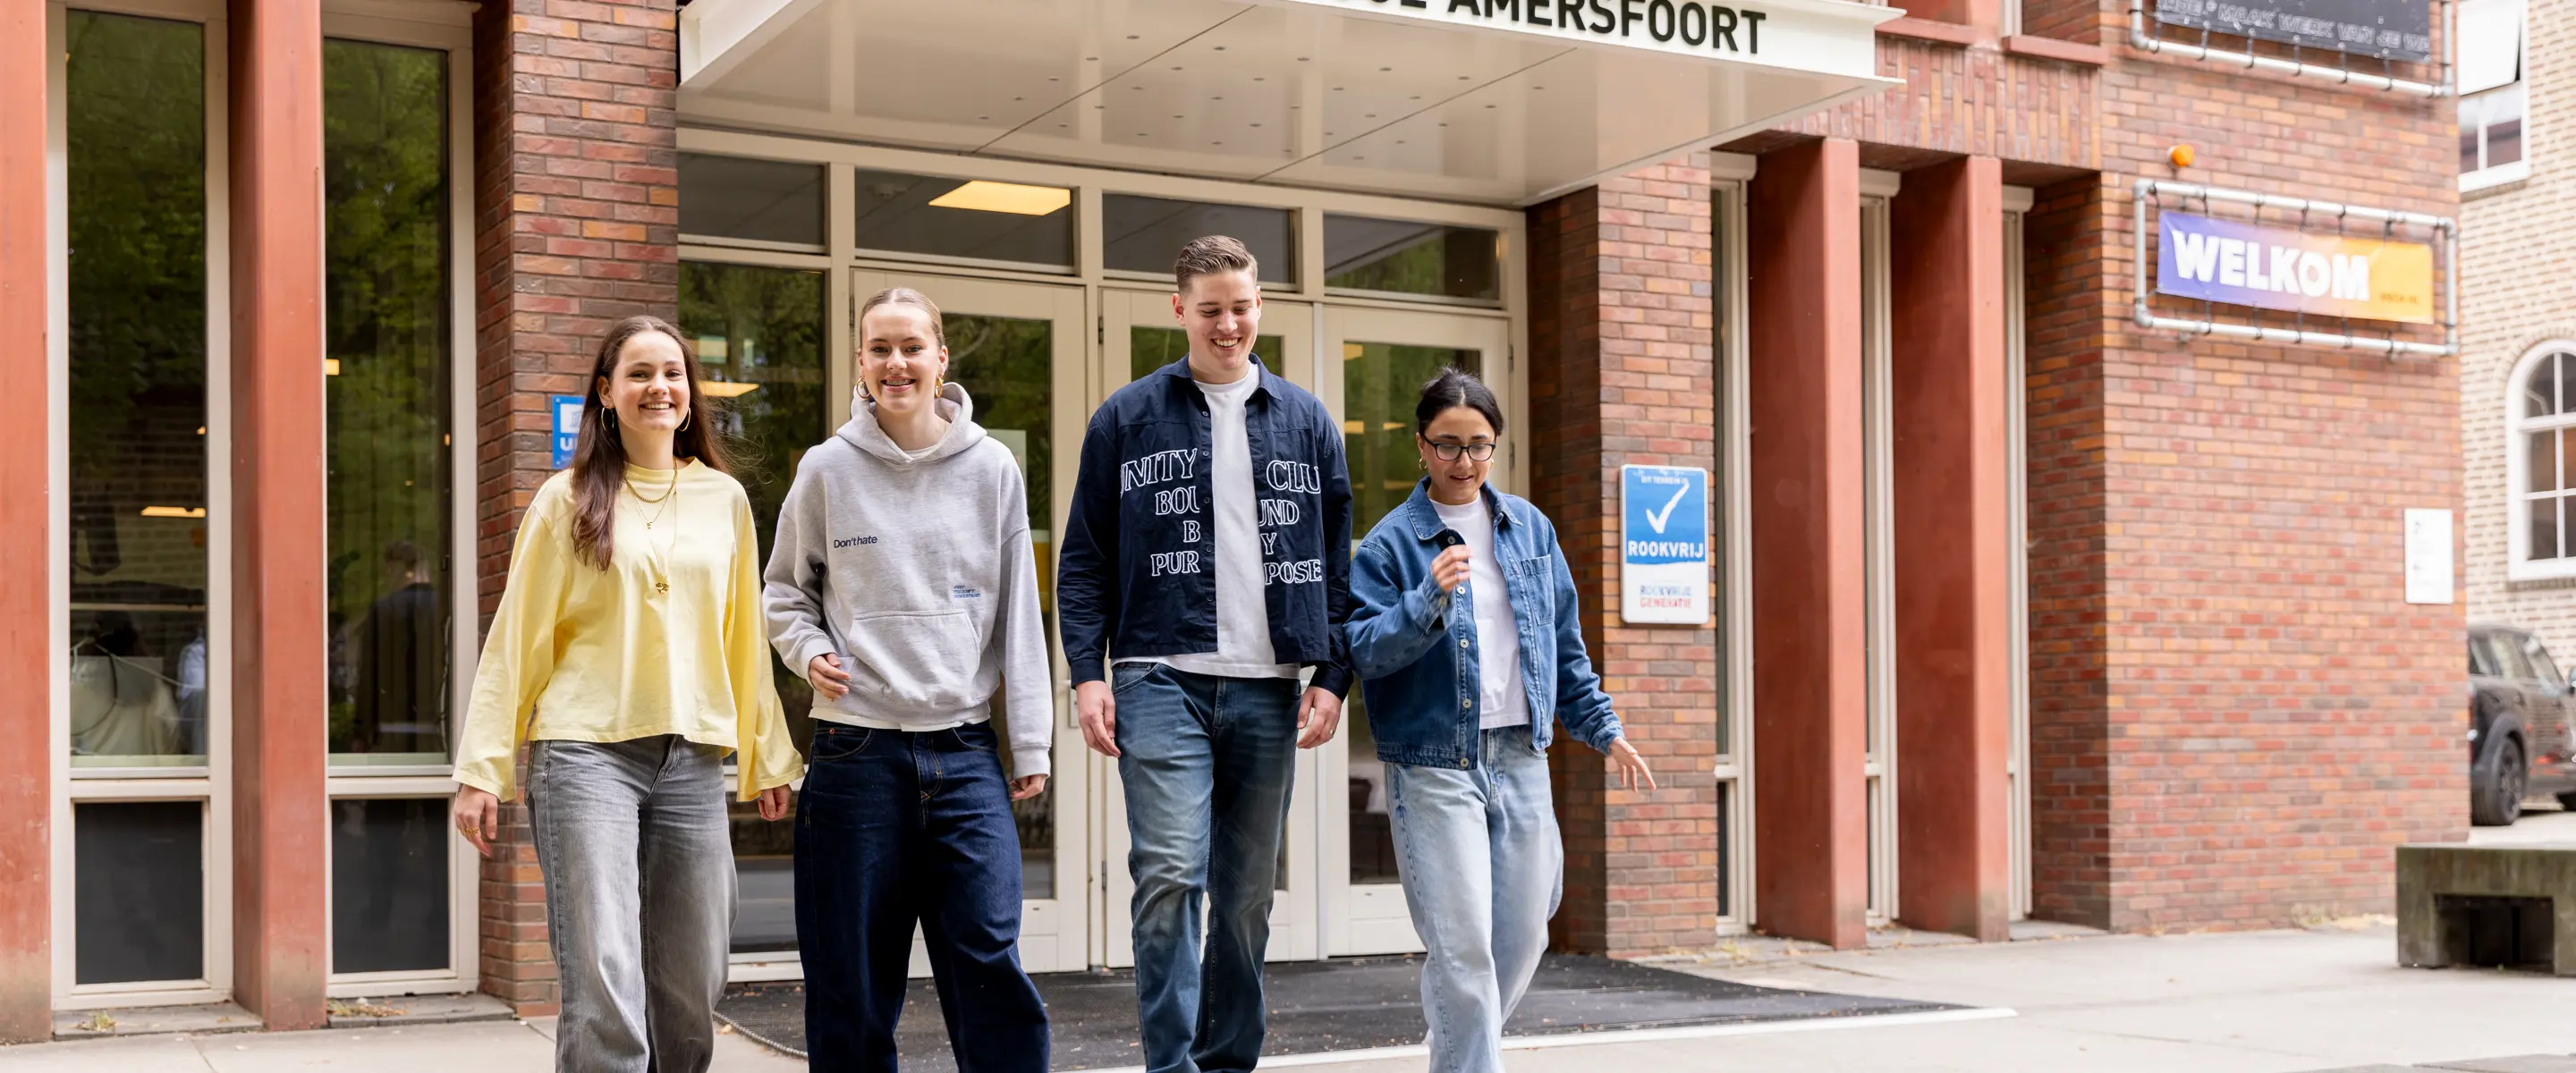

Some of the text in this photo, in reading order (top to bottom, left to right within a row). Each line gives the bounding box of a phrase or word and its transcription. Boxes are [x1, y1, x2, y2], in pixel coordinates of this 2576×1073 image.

[2171, 229, 2370, 301] WELKOM
[1267, 460, 1321, 494] CLU
[834, 536, 877, 548] Don't hate
[1183, 520, 1277, 554] B Y
[1628, 540, 1704, 558] ROOKVRIJ
[1150, 551, 1322, 585] PUR POSE
